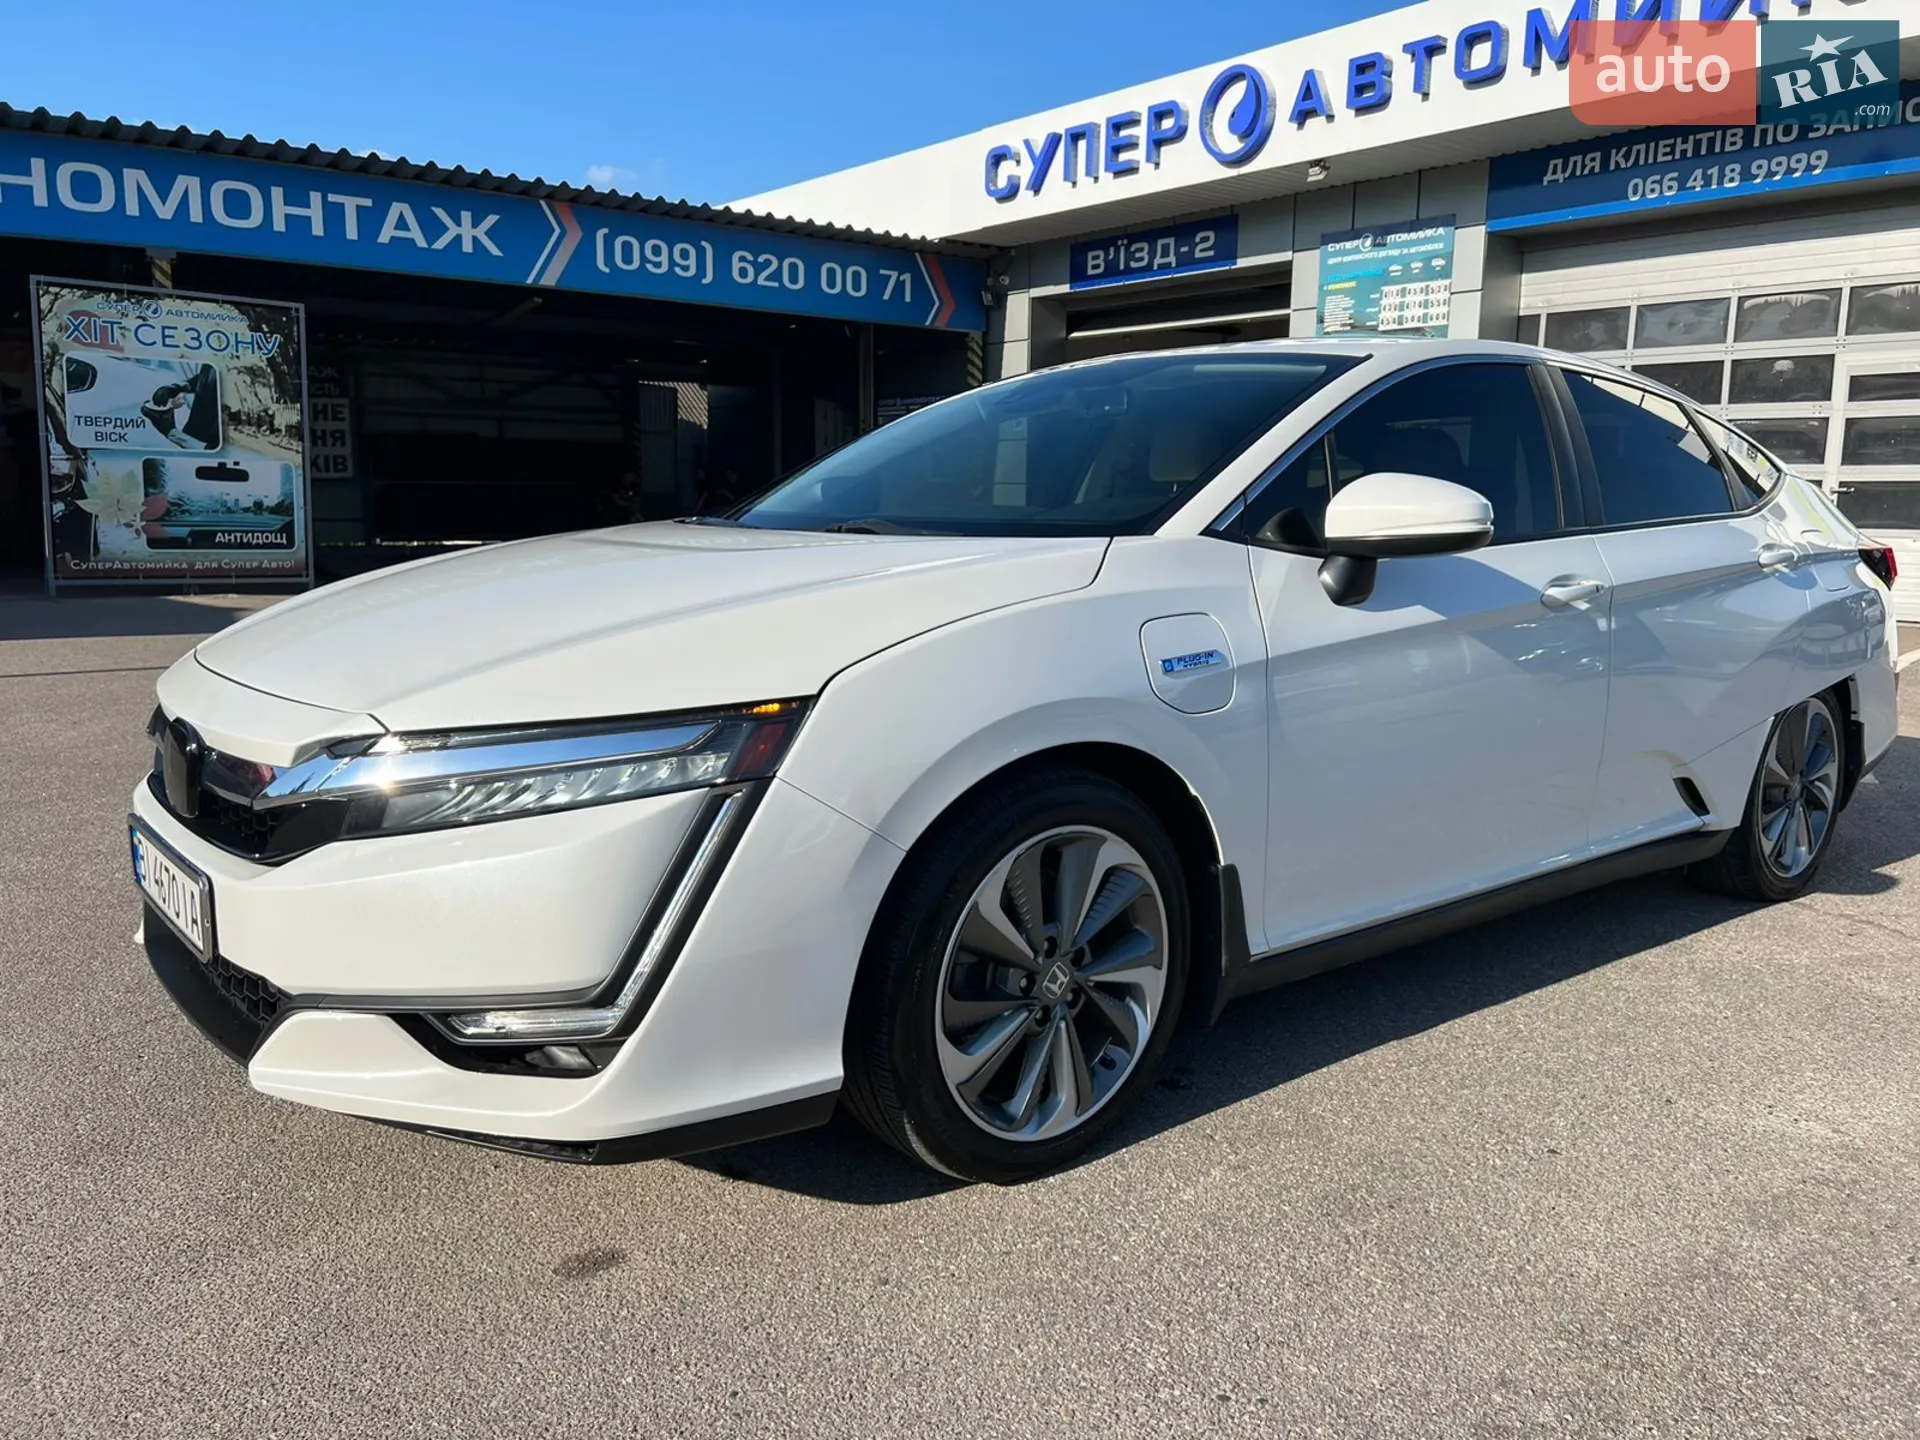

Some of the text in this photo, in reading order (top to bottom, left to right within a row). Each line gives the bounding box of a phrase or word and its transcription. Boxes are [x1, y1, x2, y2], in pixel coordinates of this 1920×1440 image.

[984, 99, 1189, 202] СУПЕР
[1543, 150, 1602, 186] ДЛЯ
[1753, 115, 1799, 148] ПО
[1627, 148, 1828, 201] 066 418 9999
[1327, 240, 1360, 251] СУПЕР
[595, 228, 912, 302] (099) 620 00 71
[96, 301, 250, 323] СУПЕР АВТОМИЙКА
[65, 316, 281, 358] ХІТ СЕЗОНУ
[74, 413, 147, 431] ТВЕРДИЙ
[95, 431, 129, 443] ВІСК
[215, 531, 288, 546] АНТИДОЩ
[1176, 651, 1214, 664] PLUG-IN
